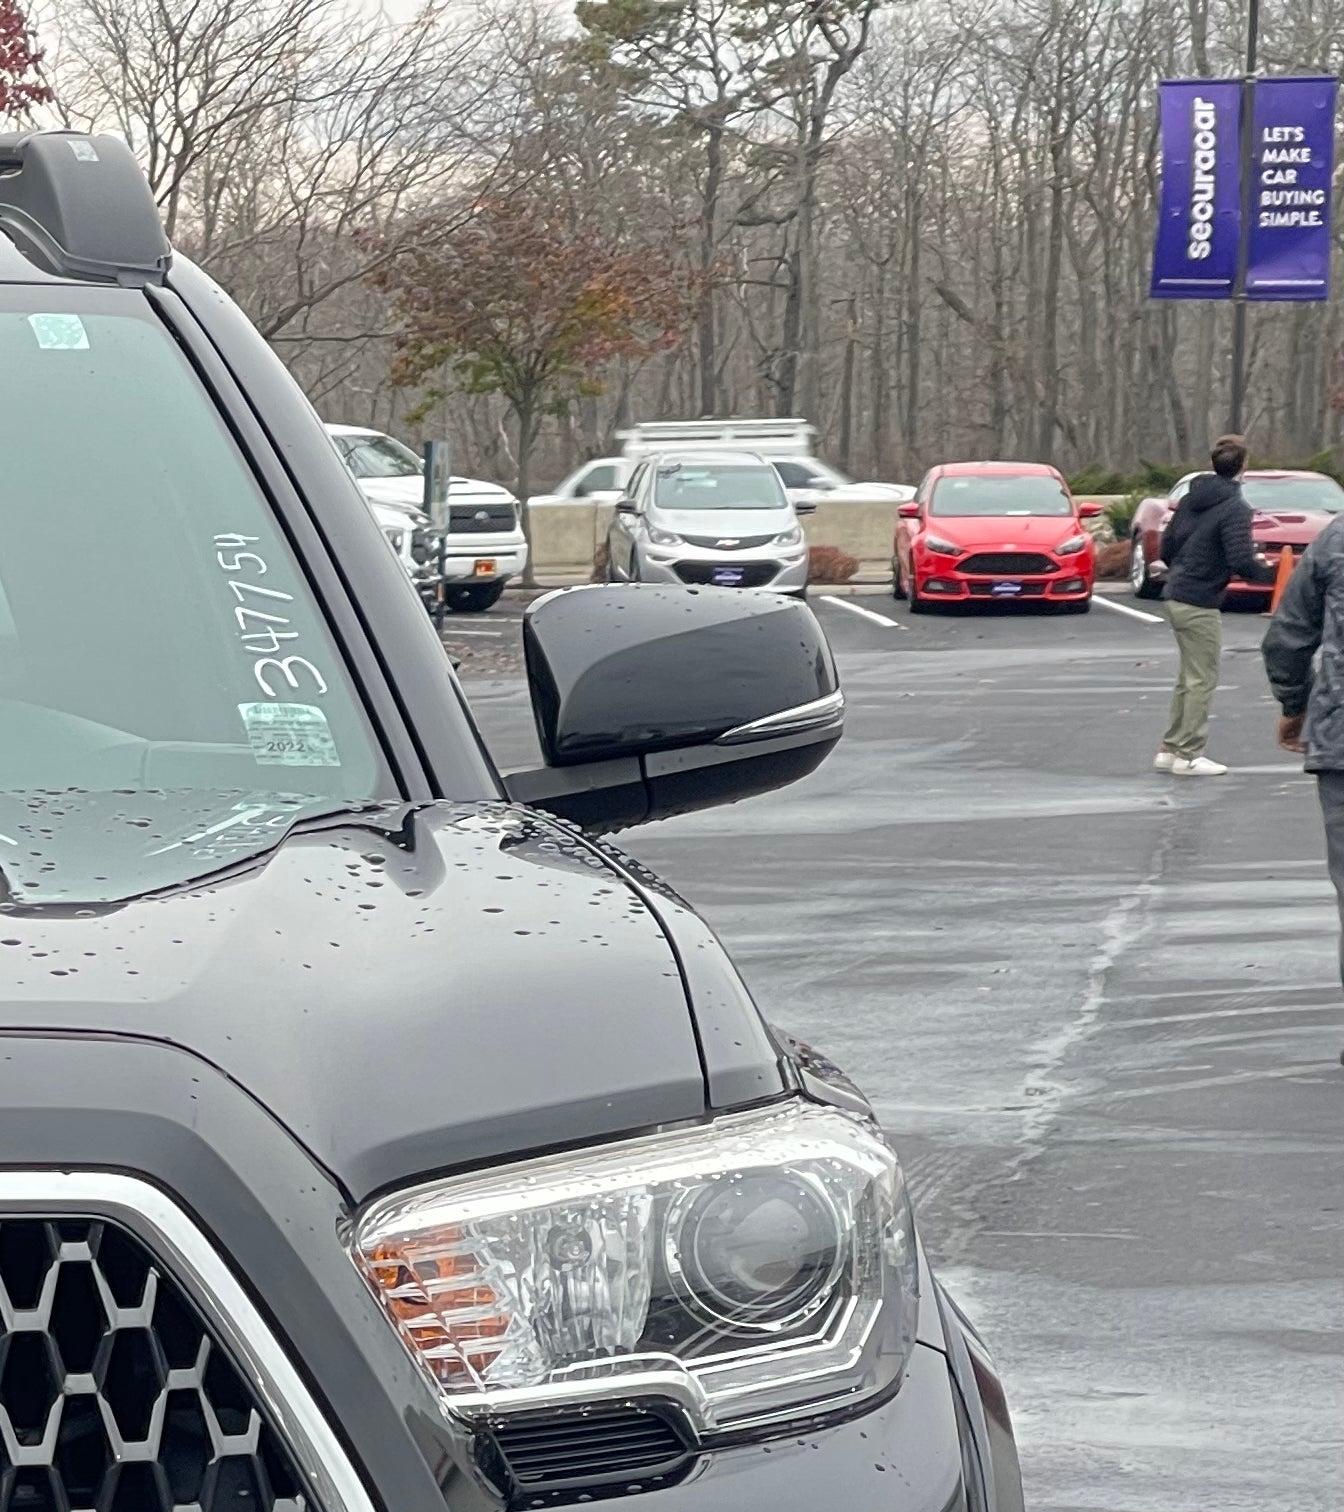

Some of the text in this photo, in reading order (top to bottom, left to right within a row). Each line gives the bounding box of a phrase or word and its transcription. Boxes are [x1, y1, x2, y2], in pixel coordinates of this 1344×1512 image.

[1262, 126, 1304, 142] LET'S
[1262, 148, 1311, 164] MAKE
[1187, 97, 1215, 260] securacar
[1262, 169, 1297, 184] CAR
[1261, 190, 1325, 206] BUYING
[1259, 211, 1323, 227] SIMPLE.
